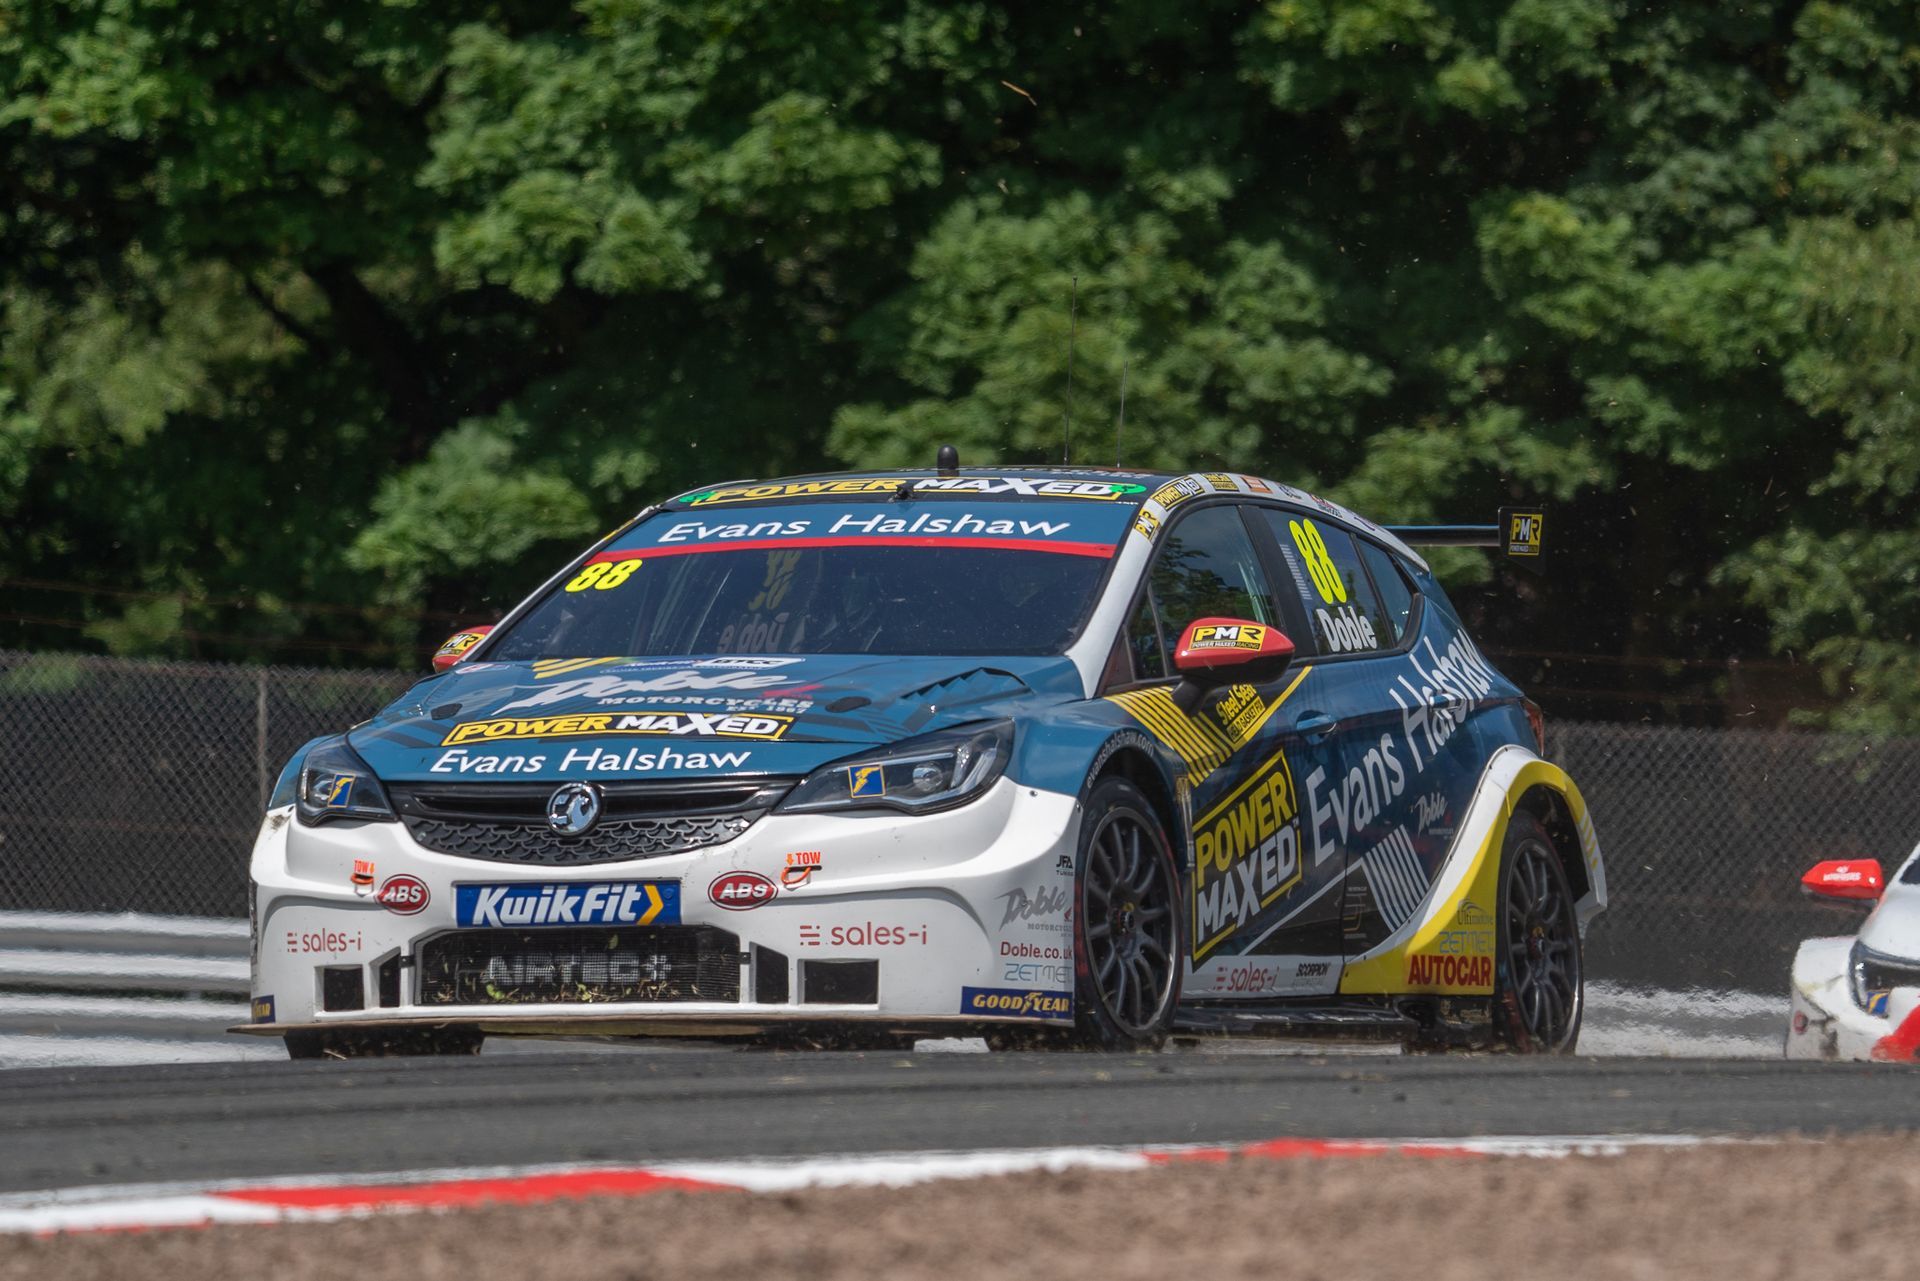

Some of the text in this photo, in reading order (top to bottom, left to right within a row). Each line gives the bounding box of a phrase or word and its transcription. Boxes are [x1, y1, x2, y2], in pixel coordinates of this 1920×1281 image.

[707, 477, 1114, 501] POWER MAXED
[657, 513, 1071, 543] Evans Halshaw
[1135, 511, 1157, 538] PMR
[1511, 517, 1540, 542] PMR
[1289, 518, 1347, 604] 88
[564, 559, 643, 592] 88
[1194, 626, 1262, 641] PMR
[1316, 606, 1378, 652] Doble
[1192, 641, 1214, 649] POWER
[1236, 642, 1259, 650] RACING
[490, 671, 807, 716] Doble
[597, 696, 814, 709] MOTORCYCLES
[1216, 689, 1242, 725] Steel
[453, 712, 779, 742] POWER MAXED
[430, 747, 752, 773] Evans Halshaw
[1086, 729, 1154, 789] evanshalshaw.com
[1305, 628, 1496, 868] Evans Halshaw
[1195, 771, 1293, 889] POWER
[354, 859, 369, 873] TOW
[796, 851, 822, 864] TOW
[382, 885, 422, 903] ABS
[719, 883, 769, 899] ABS
[1197, 824, 1296, 944] MAXED
[993, 885, 1066, 932] Doble
[302, 927, 362, 953] sales-i
[830, 921, 928, 946] sales-i
[1027, 922, 1073, 933] MOTORCY
[1000, 941, 1073, 960] Doble.co.uk
[1227, 960, 1280, 993] sales-i
[1296, 962, 1331, 977] SCORPION
[1408, 954, 1492, 987] AUTOCAR
[972, 992, 1070, 1014] GOODYEAR
